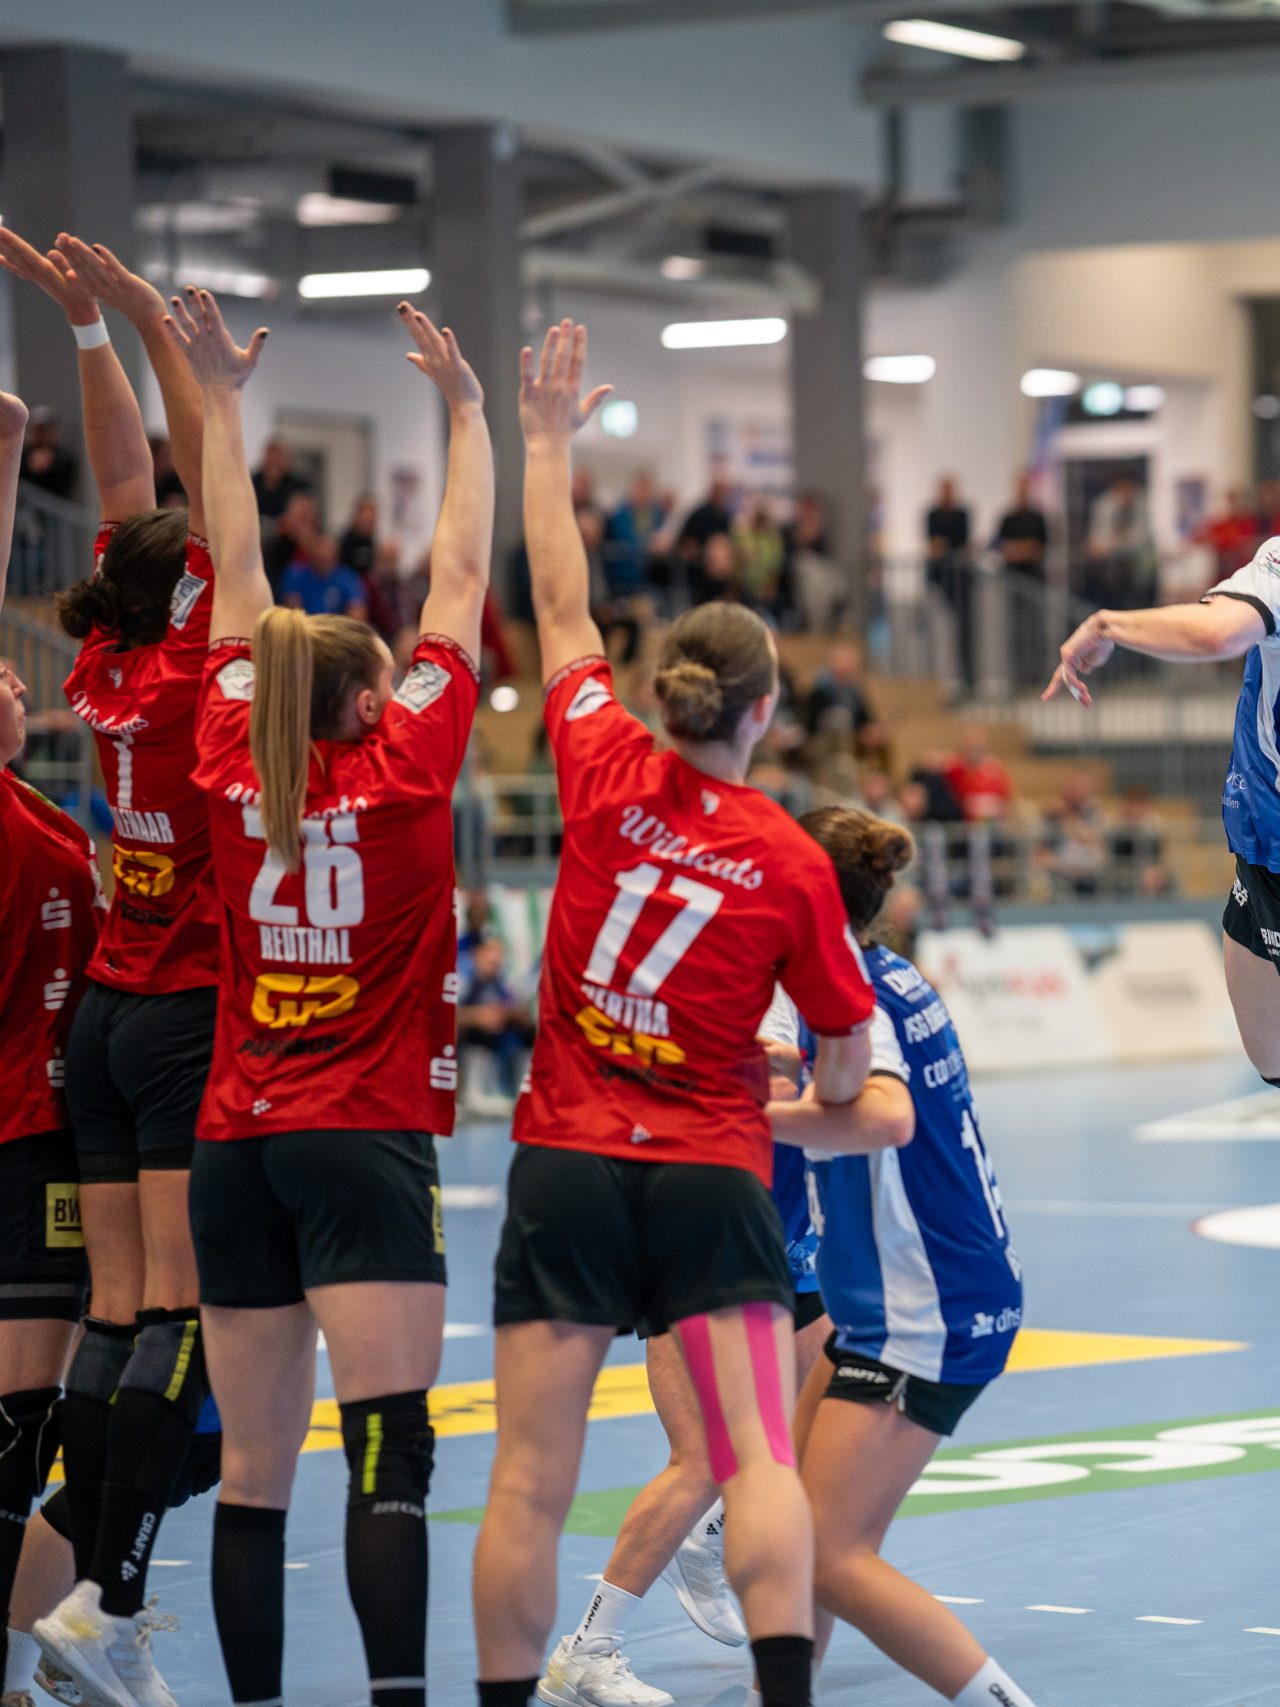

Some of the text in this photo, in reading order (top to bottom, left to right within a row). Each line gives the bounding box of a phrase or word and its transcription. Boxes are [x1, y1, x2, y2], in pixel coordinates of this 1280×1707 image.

[248, 805, 365, 928] 26
[622, 804, 765, 891] Wildcats
[582, 862, 725, 998] 17
[130, 1511, 156, 1561] CRAFT
